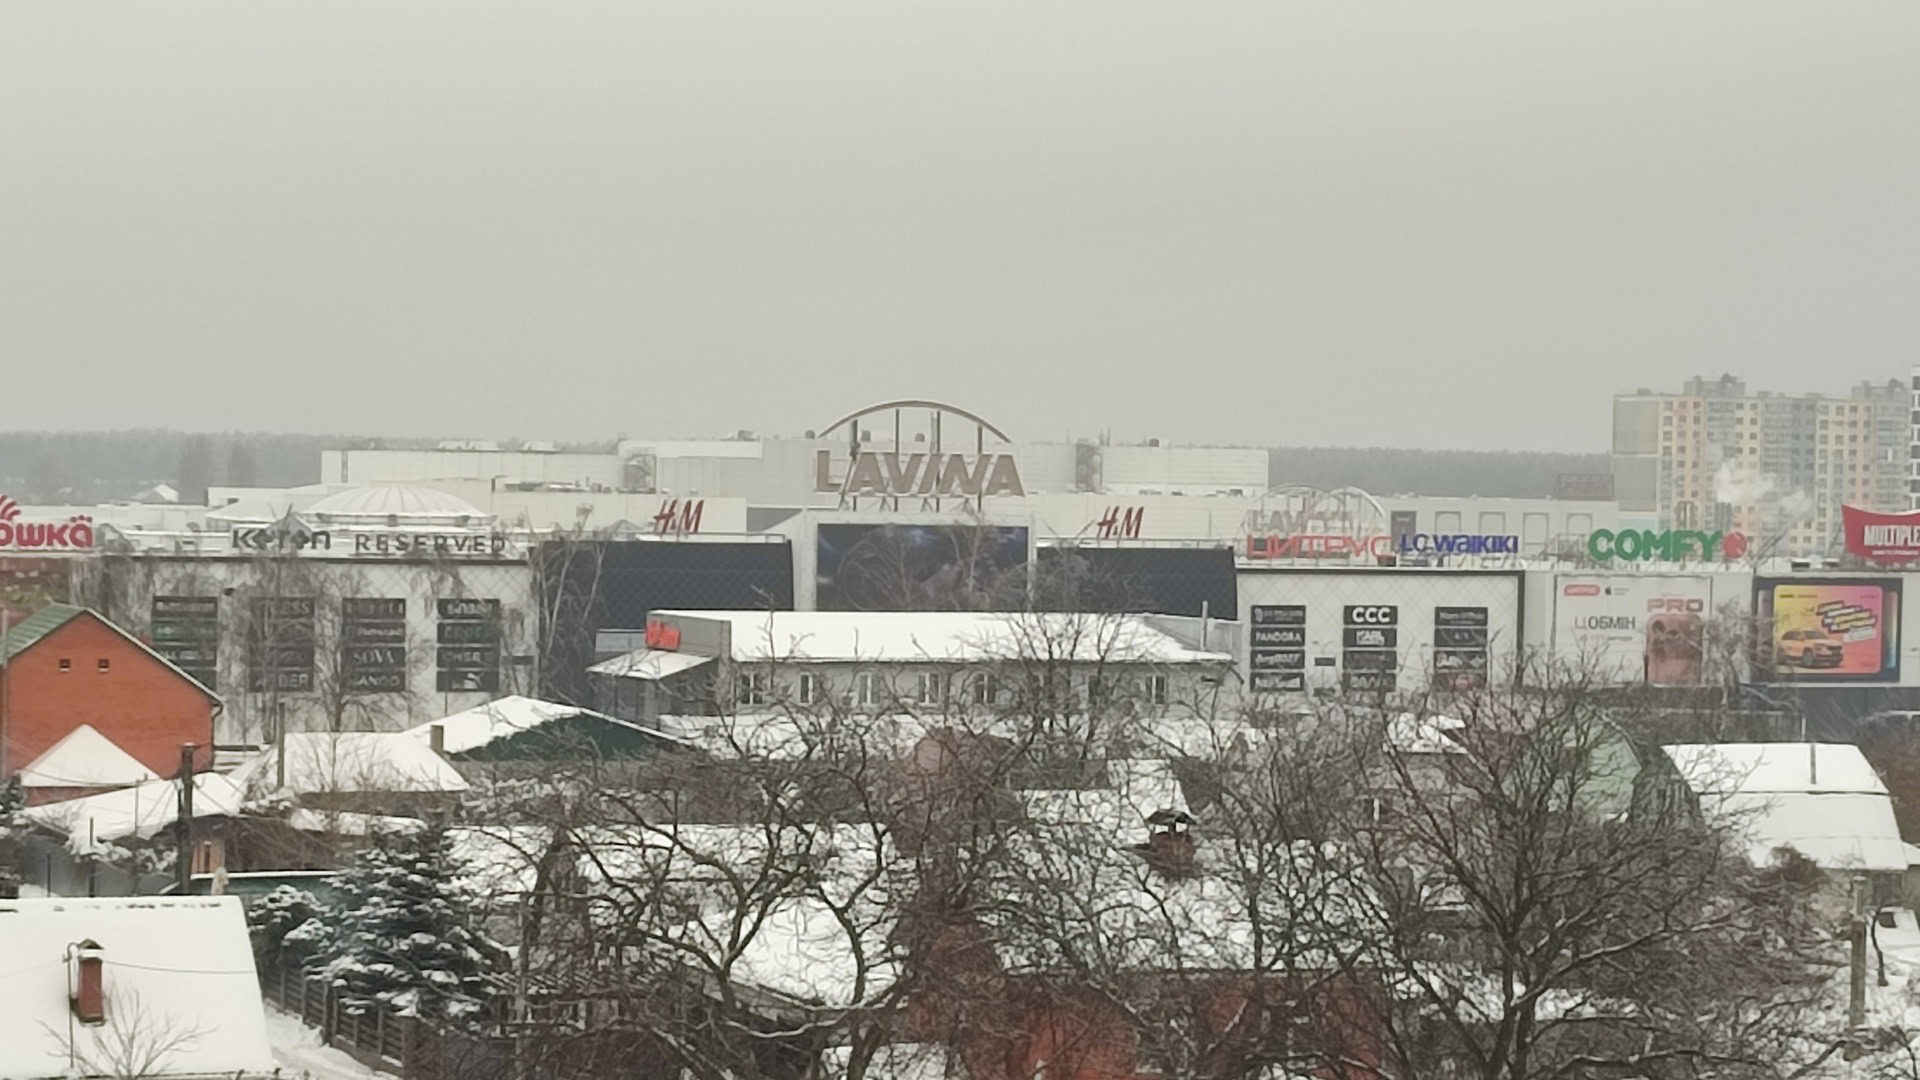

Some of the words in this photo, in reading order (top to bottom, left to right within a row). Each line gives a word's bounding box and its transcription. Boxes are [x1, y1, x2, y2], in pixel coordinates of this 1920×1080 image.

[814, 449, 1026, 497] LAVINA
[653, 498, 704, 535] H&M
[1098, 504, 1145, 540] H&M
[354, 532, 506, 552] RESERVED
[1247, 534, 1393, 559] ЦИТРУС
[1588, 528, 1724, 562] COMFY
[1352, 606, 1391, 623] CCC
[1647, 598, 1704, 613] PRO
[1255, 631, 1301, 643] PANDORA
